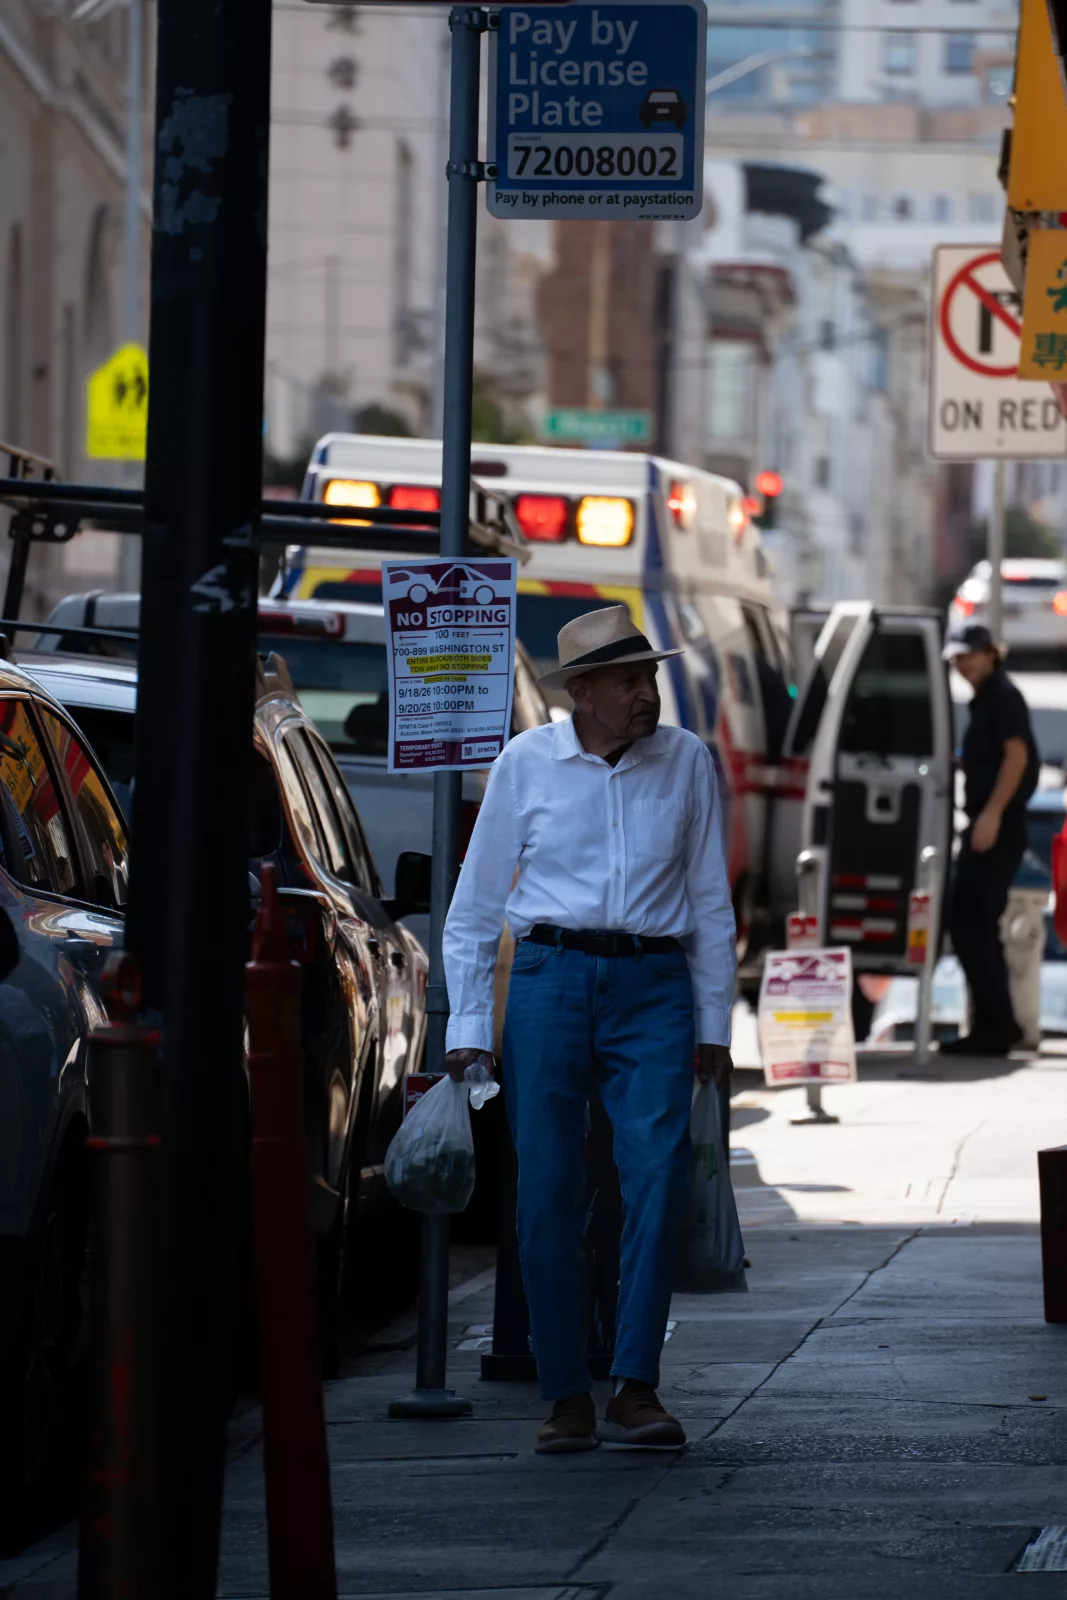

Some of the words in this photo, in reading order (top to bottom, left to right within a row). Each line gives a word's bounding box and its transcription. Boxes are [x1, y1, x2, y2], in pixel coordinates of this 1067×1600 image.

[509, 11, 578, 54] Pay
[591, 10, 639, 54] by
[509, 51, 648, 86] License
[508, 91, 604, 127] Plate
[513, 145, 677, 176] 72008002
[495, 192, 519, 207] Pay
[523, 192, 539, 207] by
[543, 192, 585, 207] phone
[589, 195, 603, 205] or
[607, 193, 620, 205] at
[624, 193, 694, 207] paystation
[939, 399, 982, 432] ON
[998, 399, 1061, 432] RED
[396, 611, 423, 627] NO
[430, 609, 506, 624] STOPPING
[435, 629, 449, 639] 100
[394, 647, 428, 657] 700-899
[429, 644, 490, 655] WASHINGTON
[492, 644, 505, 652] ST
[406, 656, 429, 665] ENTIRE
[426, 664, 440, 672] AWAY
[440, 663, 450, 671] NO
[398, 687, 431, 698] 9/18/26
[433, 685, 475, 695] 10:00PM
[478, 686, 489, 694] to
[398, 702, 431, 714] 9/20/26
[433, 700, 475, 710] 10:00PM
[399, 743, 430, 752] TEMPORARY
[477, 746, 497, 754] SFMTA
